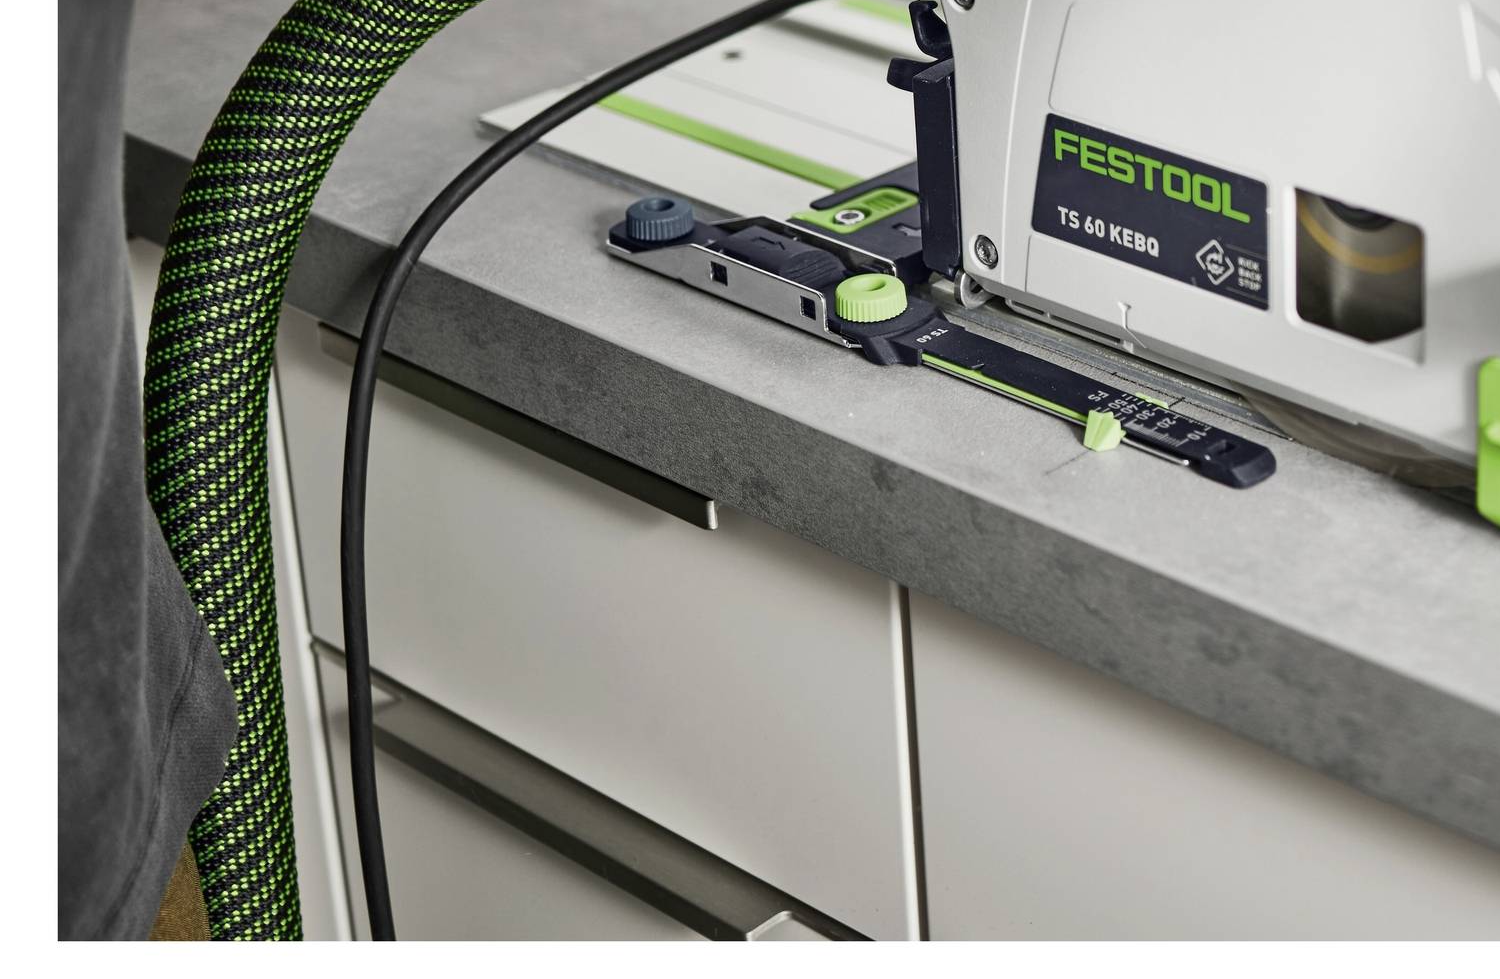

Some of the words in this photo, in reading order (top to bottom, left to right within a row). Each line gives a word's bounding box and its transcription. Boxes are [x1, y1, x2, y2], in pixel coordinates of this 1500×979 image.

[1054, 129, 1250, 223] FESTOOL
[1057, 206, 1080, 229] TS
[1084, 216, 1105, 238] 60
[1109, 223, 1160, 258] KEBQ
[1238, 277, 1262, 291] STOP
[916, 334, 932, 343] 60
[930, 328, 949, 337] TS
[1108, 399, 1128, 410] 50
[1120, 403, 1139, 415] 40
[1135, 409, 1156, 421] 30
[1156, 417, 1177, 429] 20
[1186, 430, 1207, 441] 10
